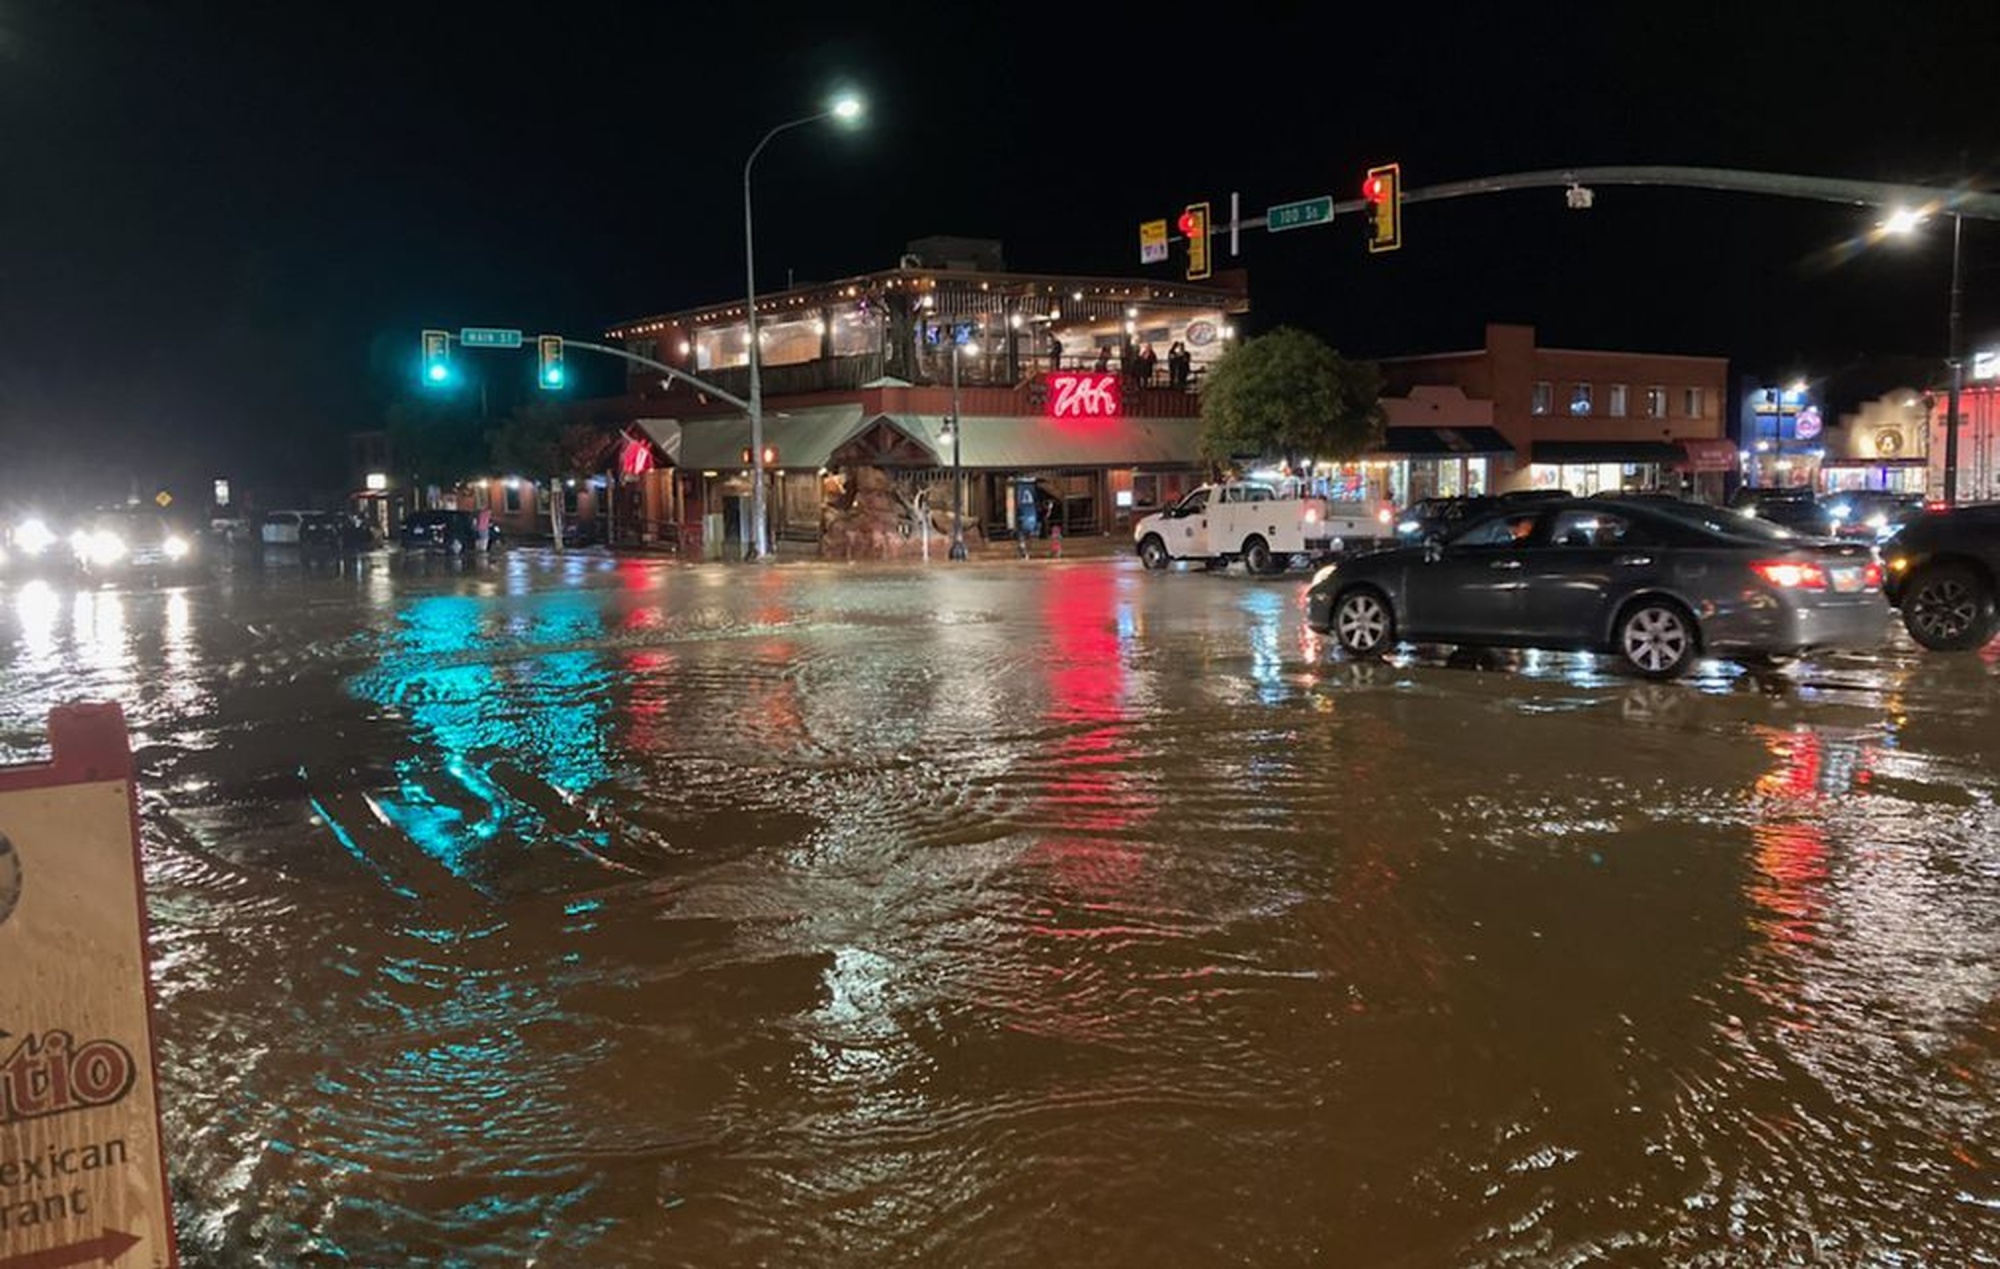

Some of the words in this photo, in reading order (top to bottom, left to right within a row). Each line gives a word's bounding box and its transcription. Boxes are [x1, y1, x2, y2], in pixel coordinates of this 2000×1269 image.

[468, 332, 494, 343] MAIN
[0, 1029, 137, 1122] tio
[0, 1138, 127, 1188] exican
[0, 1185, 88, 1232] rant
